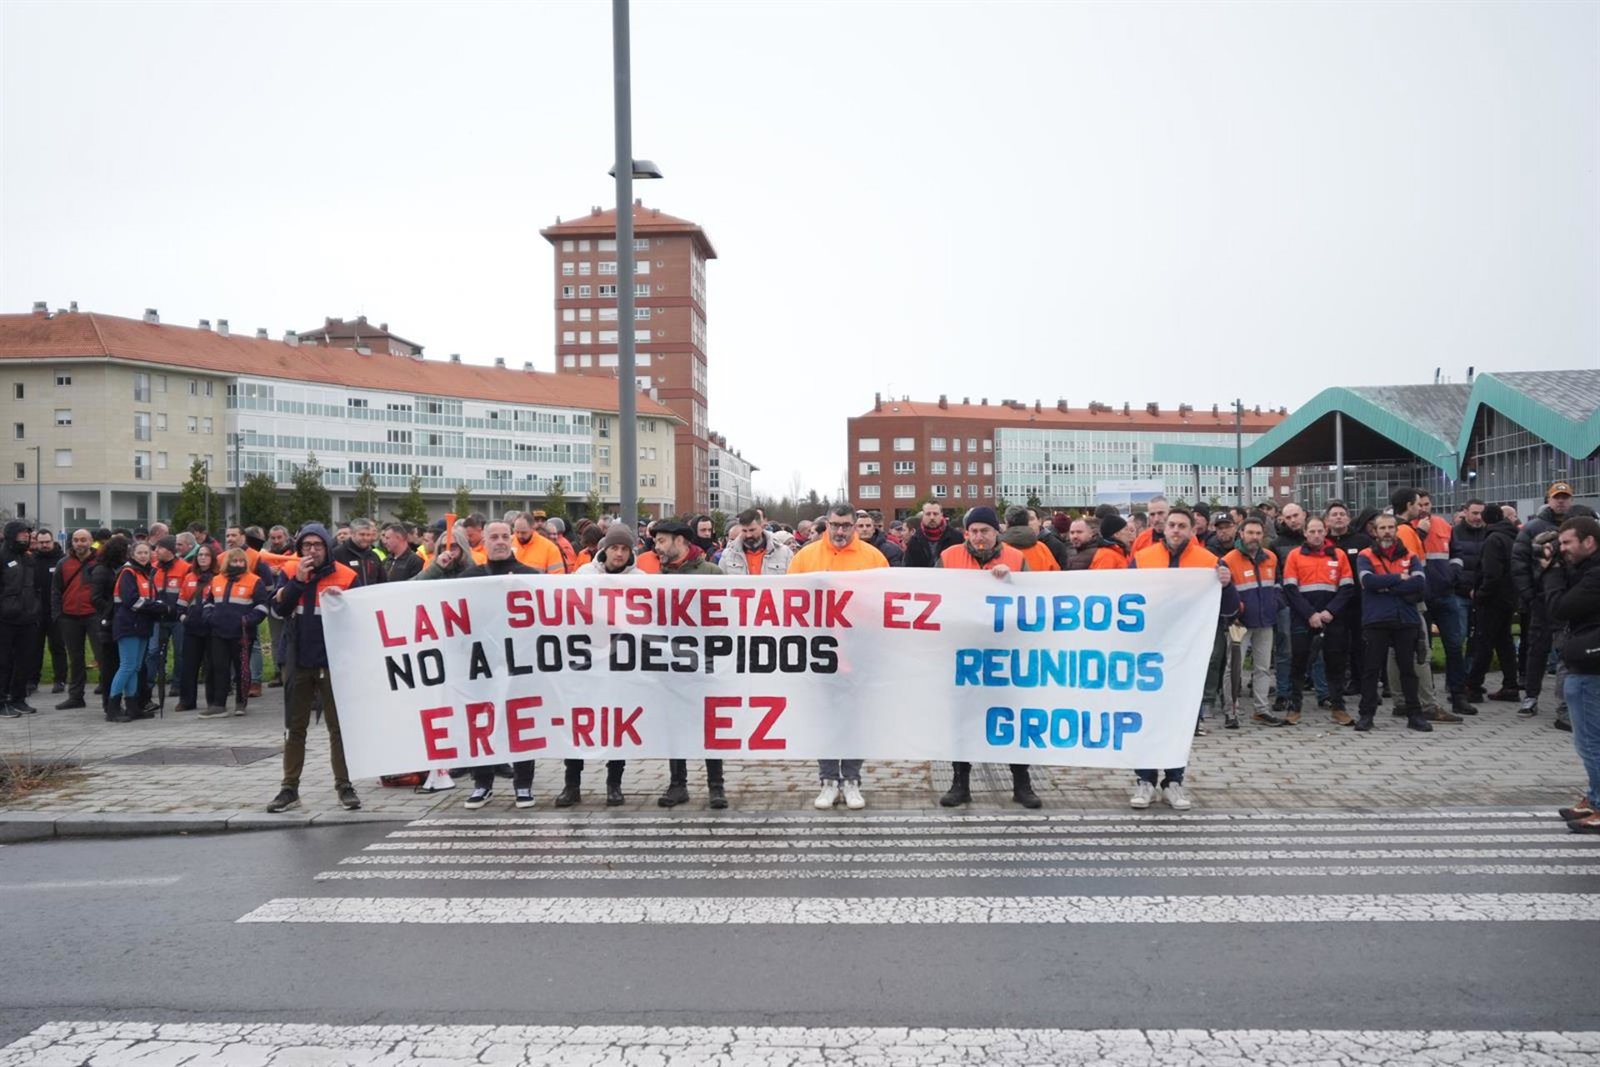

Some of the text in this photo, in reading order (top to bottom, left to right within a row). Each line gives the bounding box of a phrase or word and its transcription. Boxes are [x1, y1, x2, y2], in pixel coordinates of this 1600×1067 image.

[376, 587, 942, 647] LAN SUNTSIKETARIK EZ
[985, 592, 1147, 634] TUBOS
[385, 632, 839, 691] NO A LOS DESPIDOS
[953, 647, 1165, 693] REUNIDOS
[420, 695, 788, 761] ERE-RIK EZ
[984, 705, 1144, 752] GROUP
